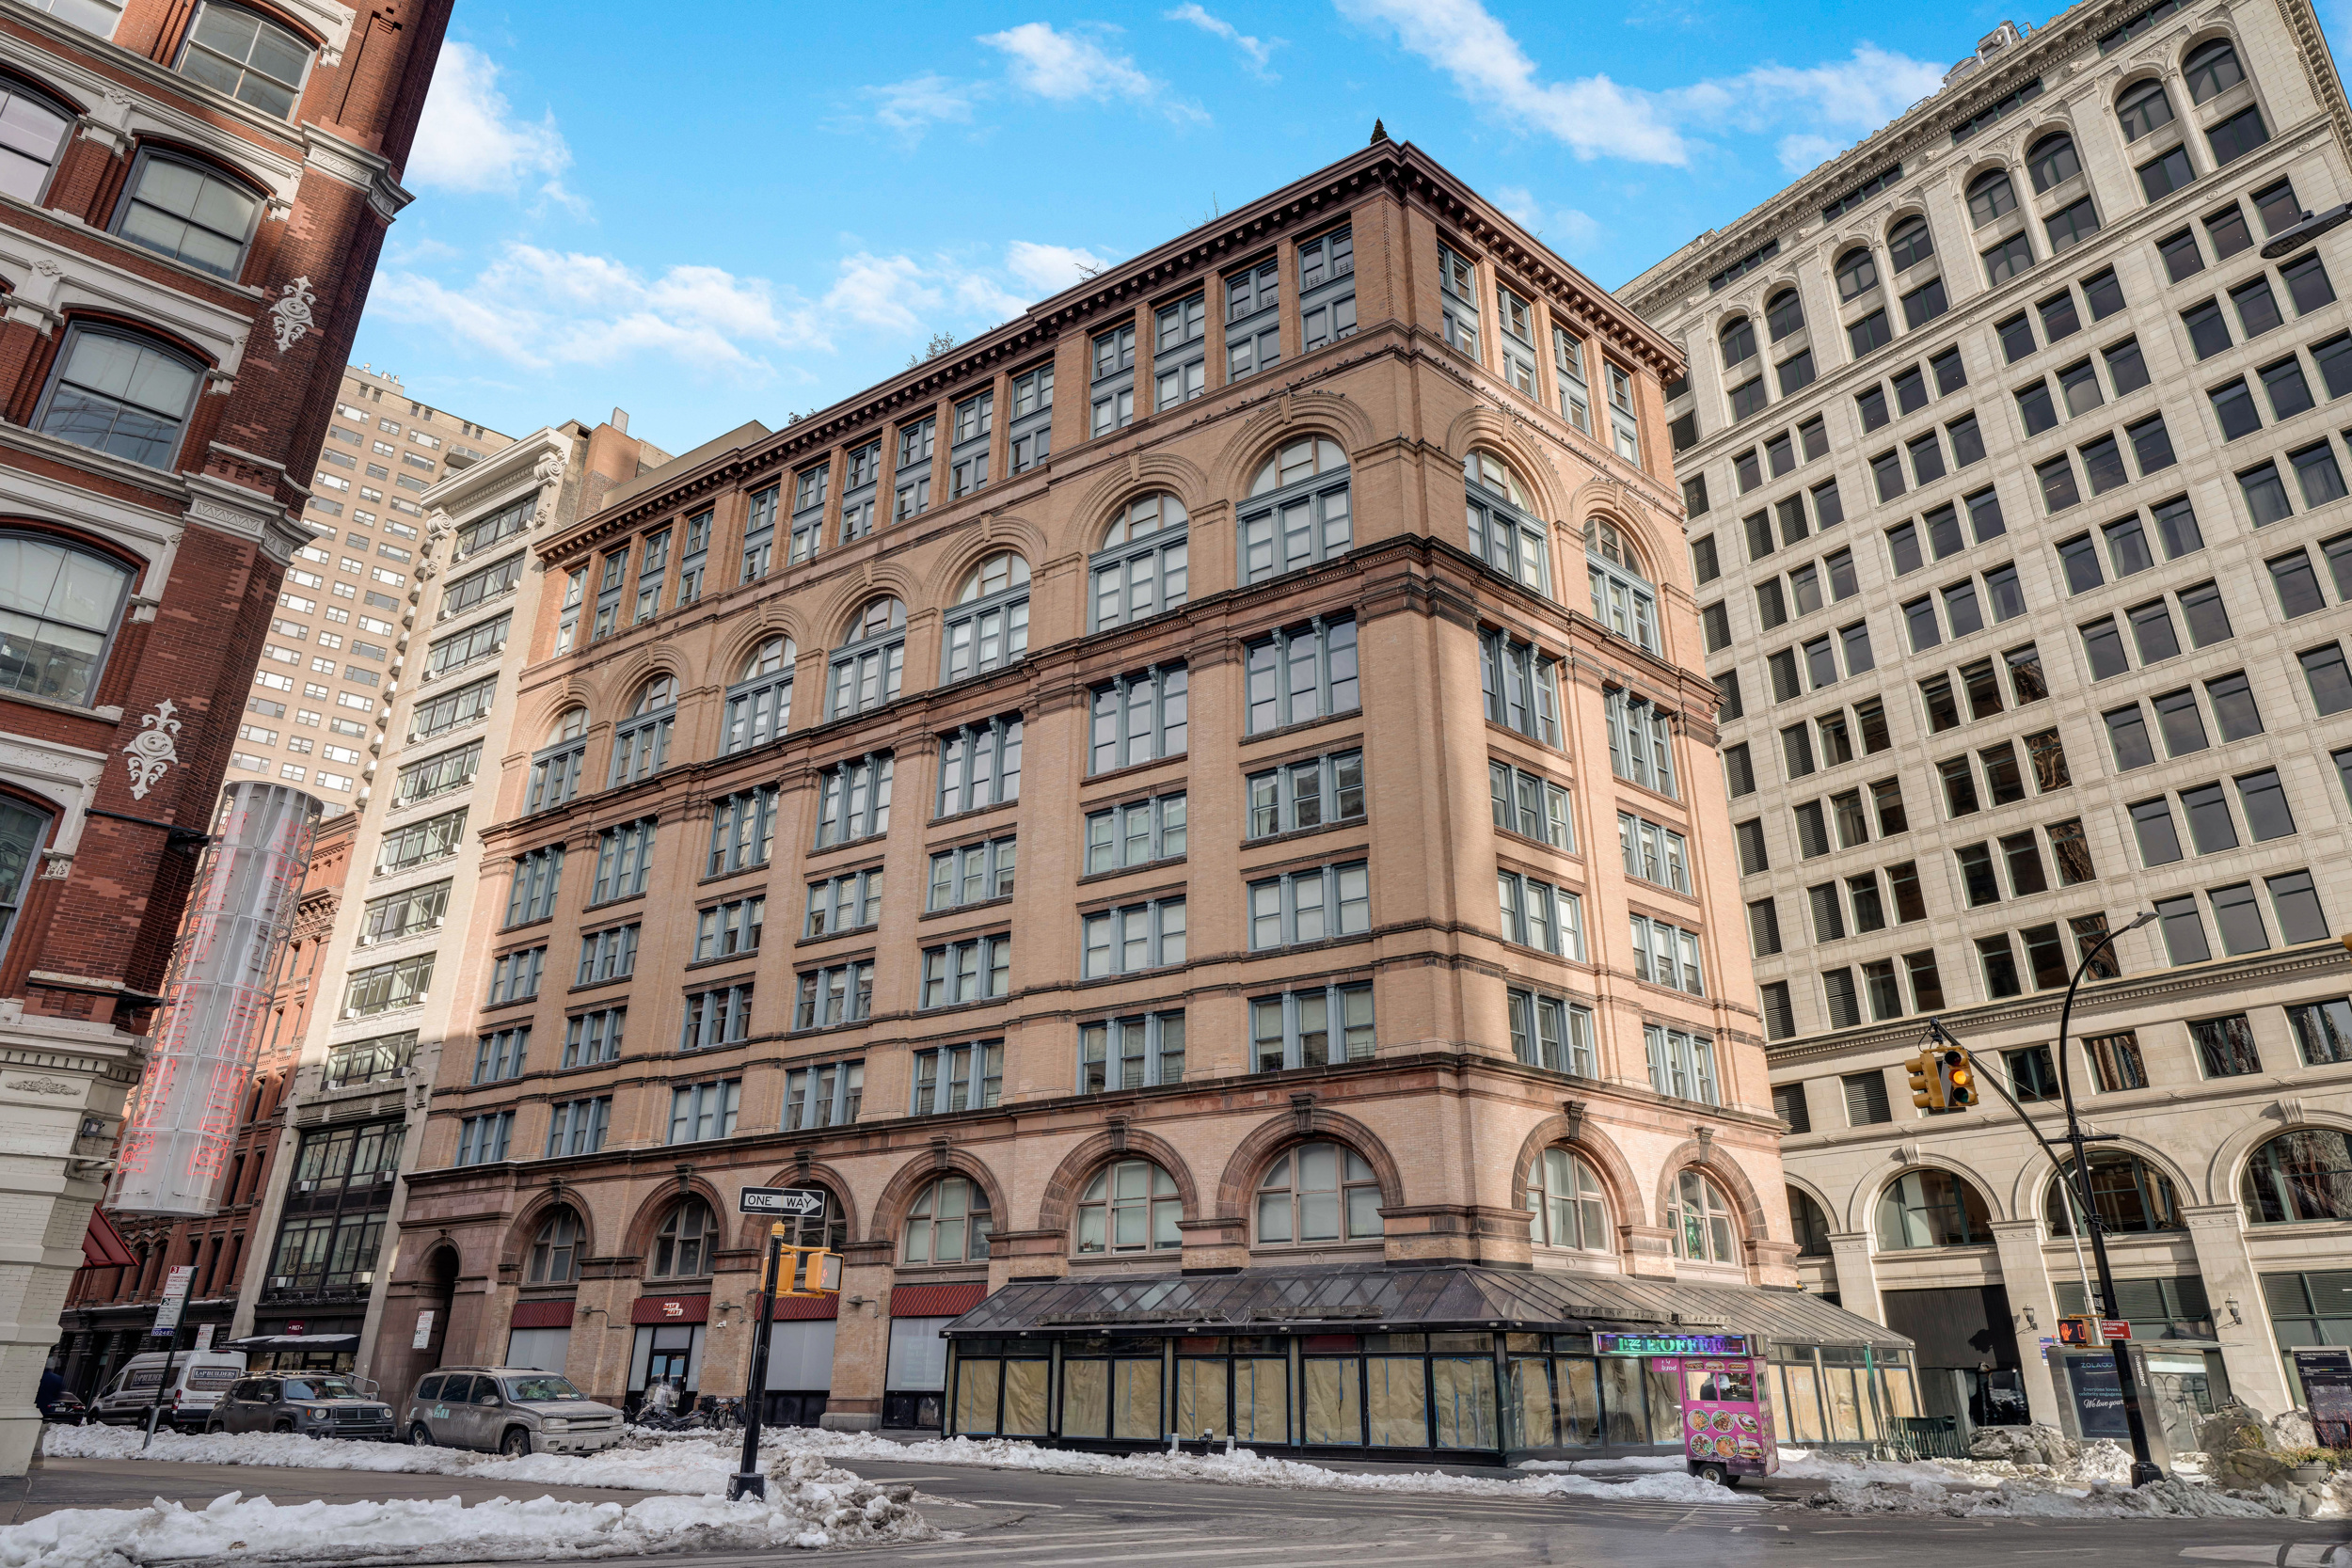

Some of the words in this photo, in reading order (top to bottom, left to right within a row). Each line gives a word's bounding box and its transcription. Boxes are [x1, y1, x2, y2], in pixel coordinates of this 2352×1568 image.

[747, 1195, 772, 1207] ONE
[787, 1196, 813, 1209] WAY
[2135, 1354, 2148, 1386] Newsstand
[2083, 1397, 2097, 1409] We
[2096, 1399, 2108, 1408] love
[2108, 1399, 2124, 1409] your
